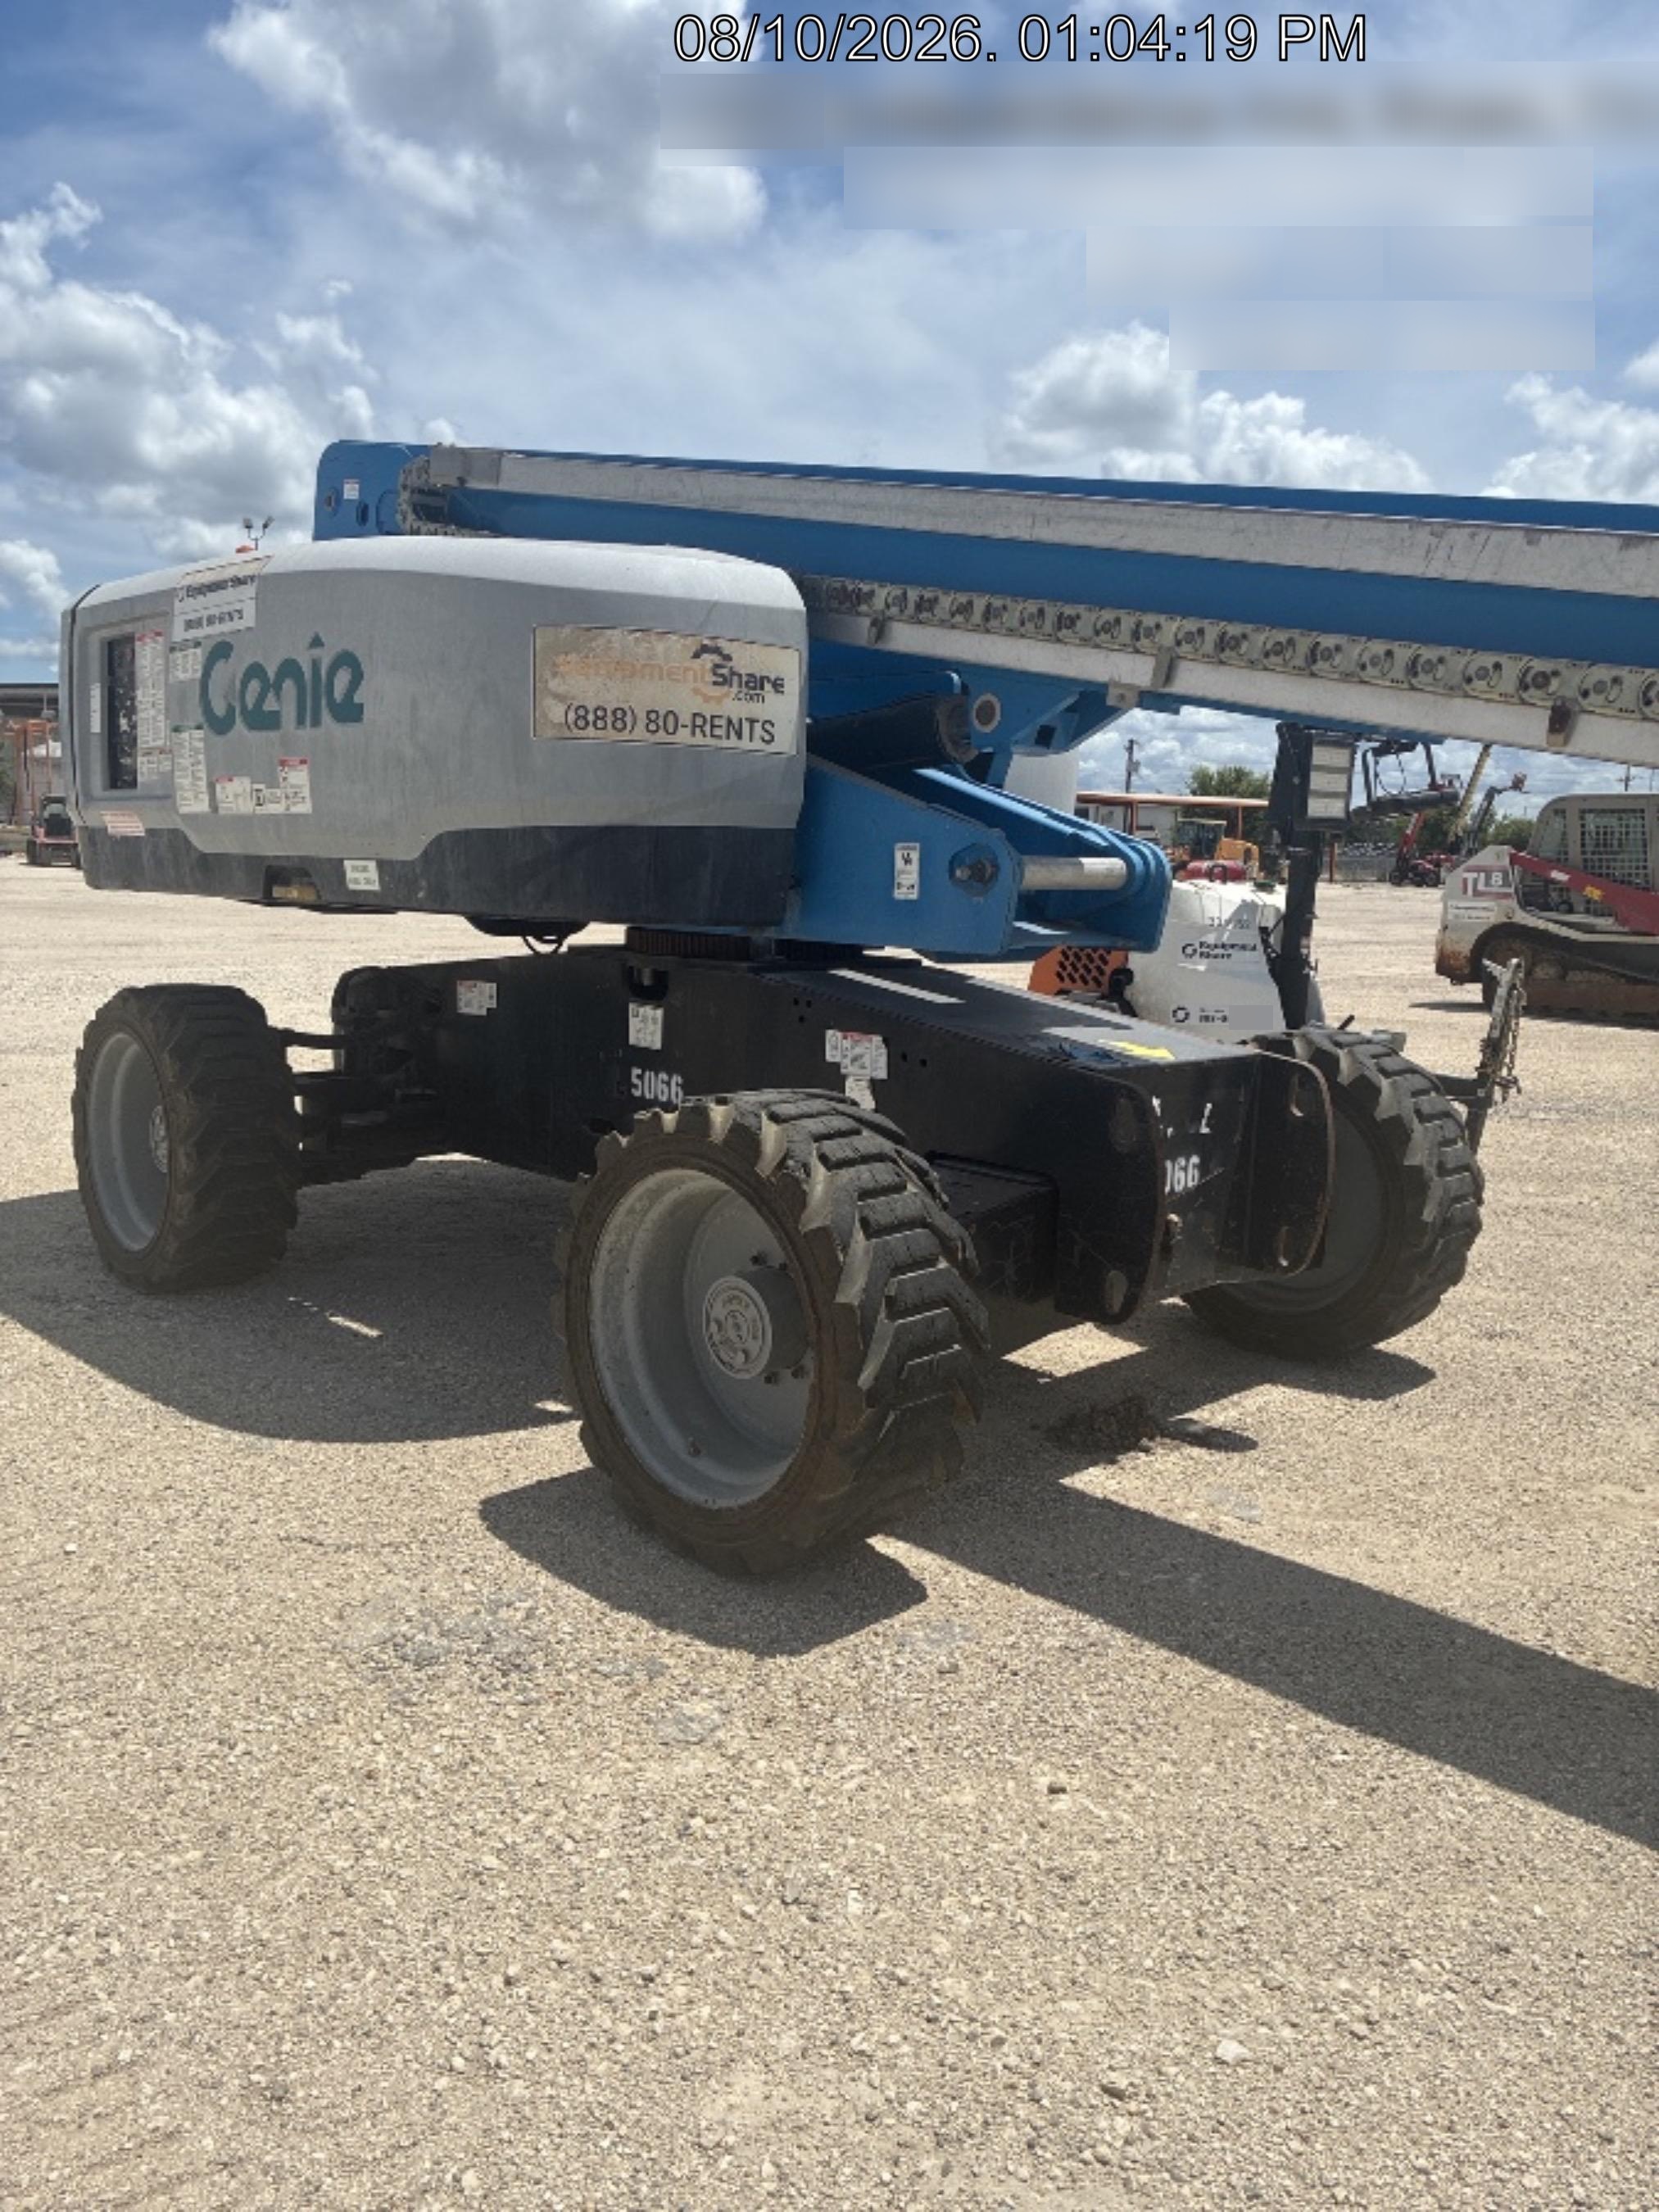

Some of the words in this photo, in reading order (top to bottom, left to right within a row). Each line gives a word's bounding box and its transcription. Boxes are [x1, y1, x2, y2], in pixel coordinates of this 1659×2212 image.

[200, 632, 364, 735] Genie
[565, 702, 637, 734] (888)
[646, 709, 775, 745] 80-RENTS
[631, 1067, 683, 1104] 5066
